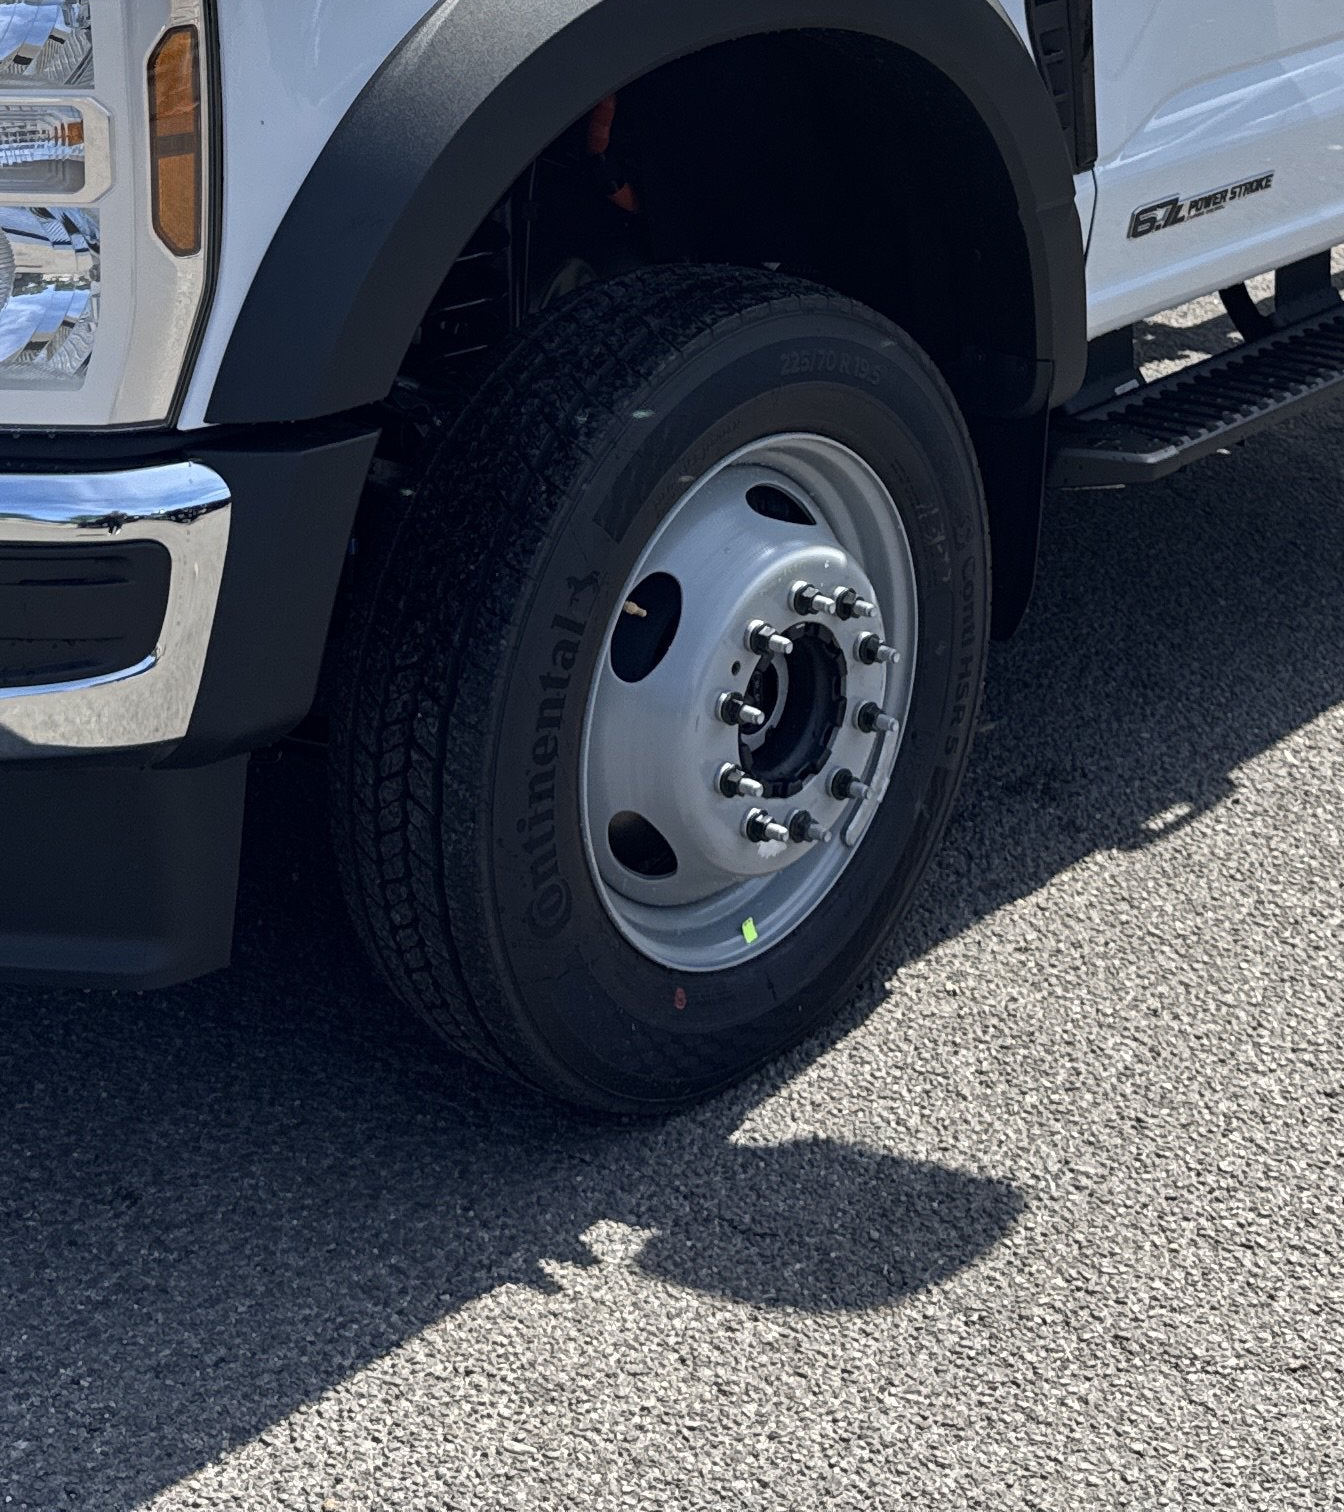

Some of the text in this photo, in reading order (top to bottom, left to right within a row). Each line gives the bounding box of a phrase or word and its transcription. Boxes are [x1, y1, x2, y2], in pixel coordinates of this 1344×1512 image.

[1127, 173, 1275, 239] 6.7L POWER STROKE
[516, 614, 587, 939] Continental
